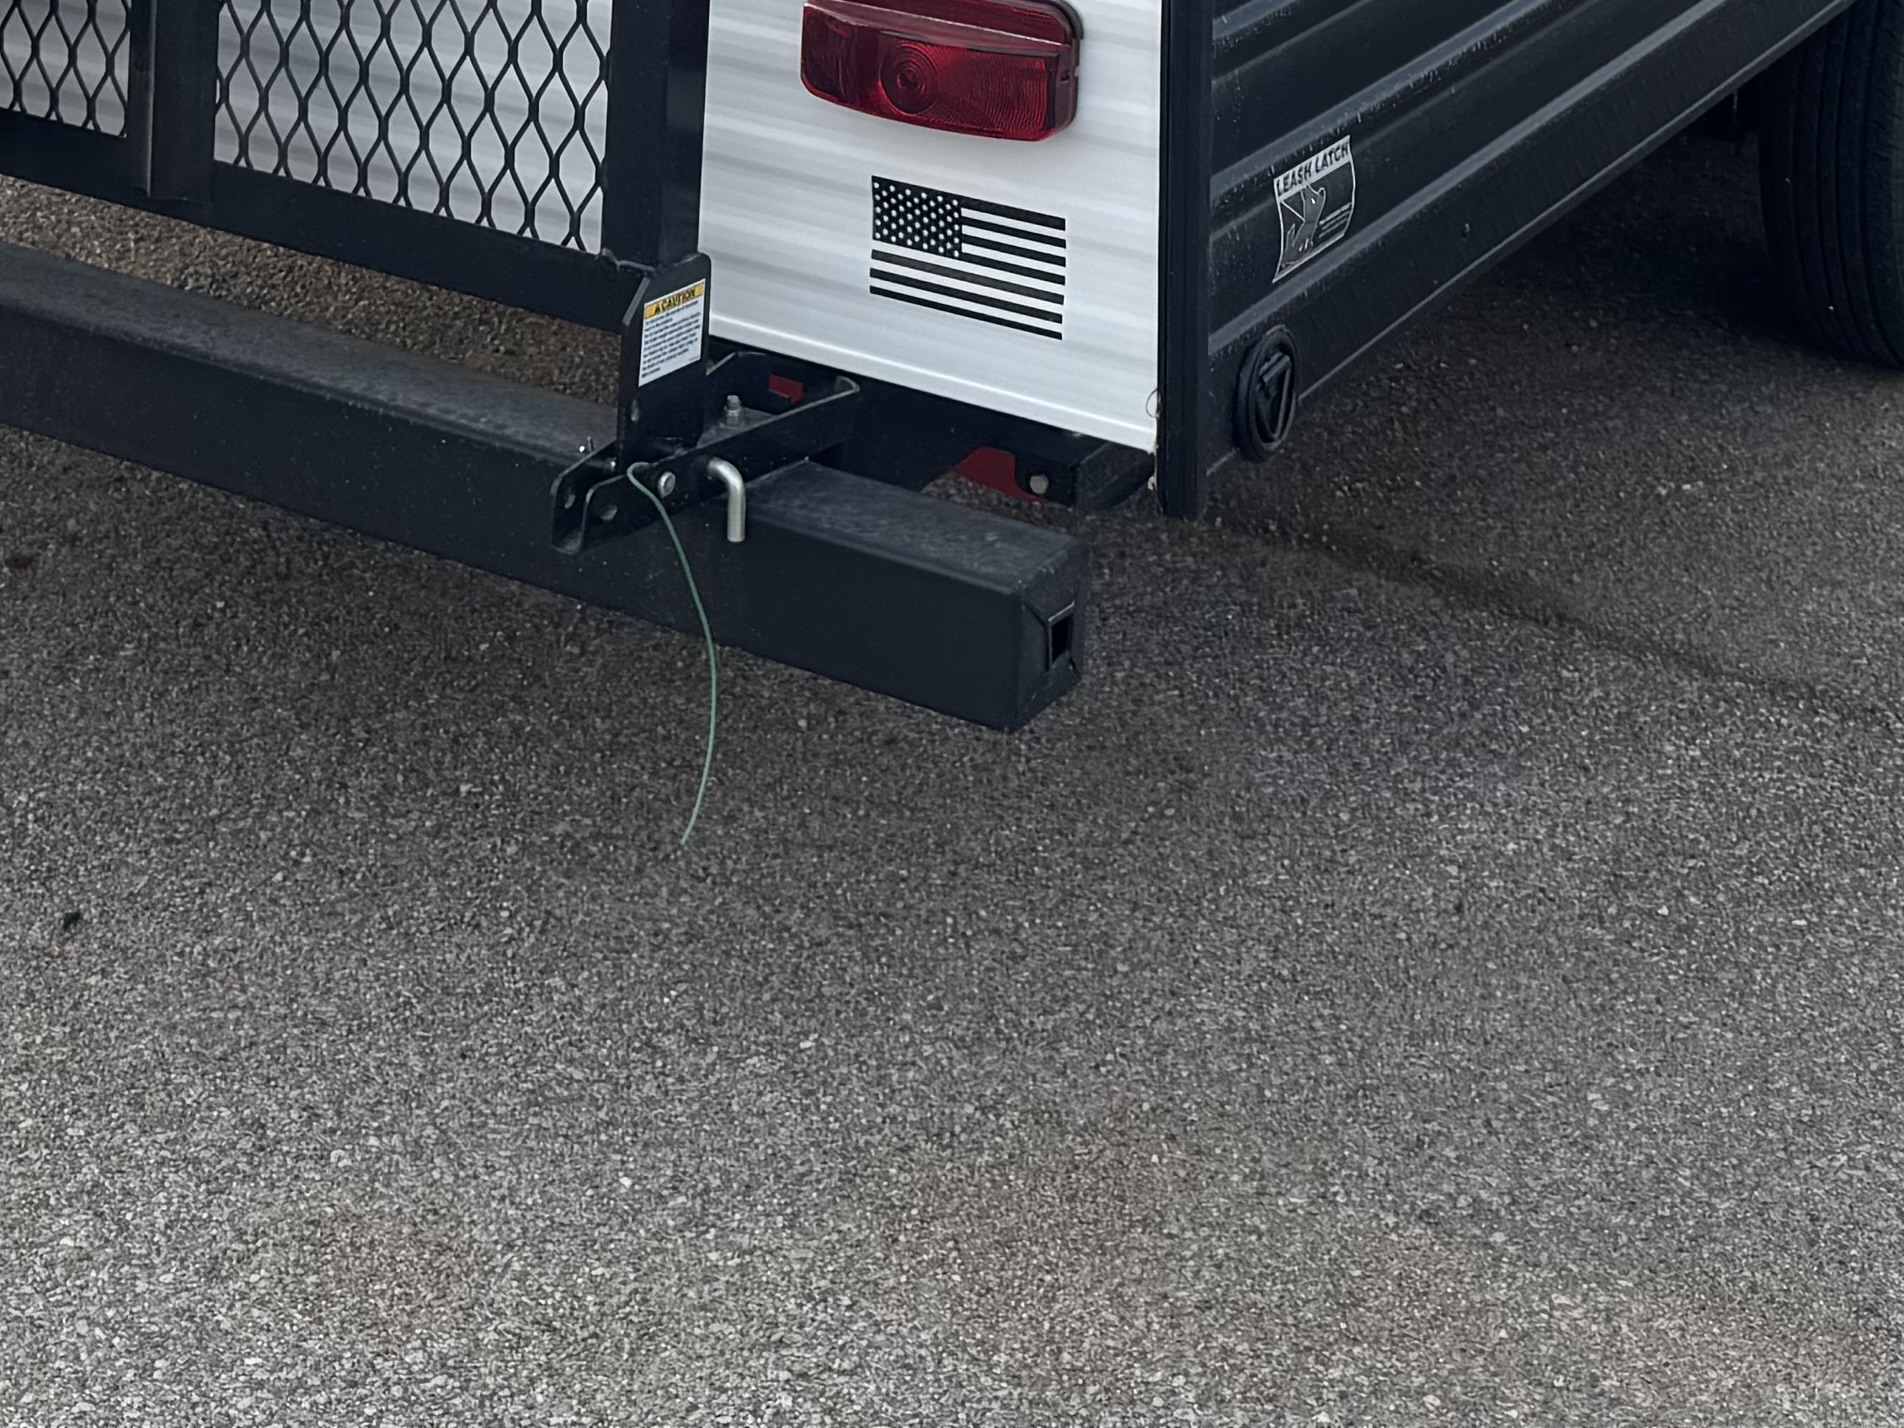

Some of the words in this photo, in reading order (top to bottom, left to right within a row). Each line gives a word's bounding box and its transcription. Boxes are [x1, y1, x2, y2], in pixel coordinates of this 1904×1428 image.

[1276, 160, 1313, 195] LEASH
[1315, 142, 1350, 173] LATCH
[660, 289, 696, 312] CAUTION
